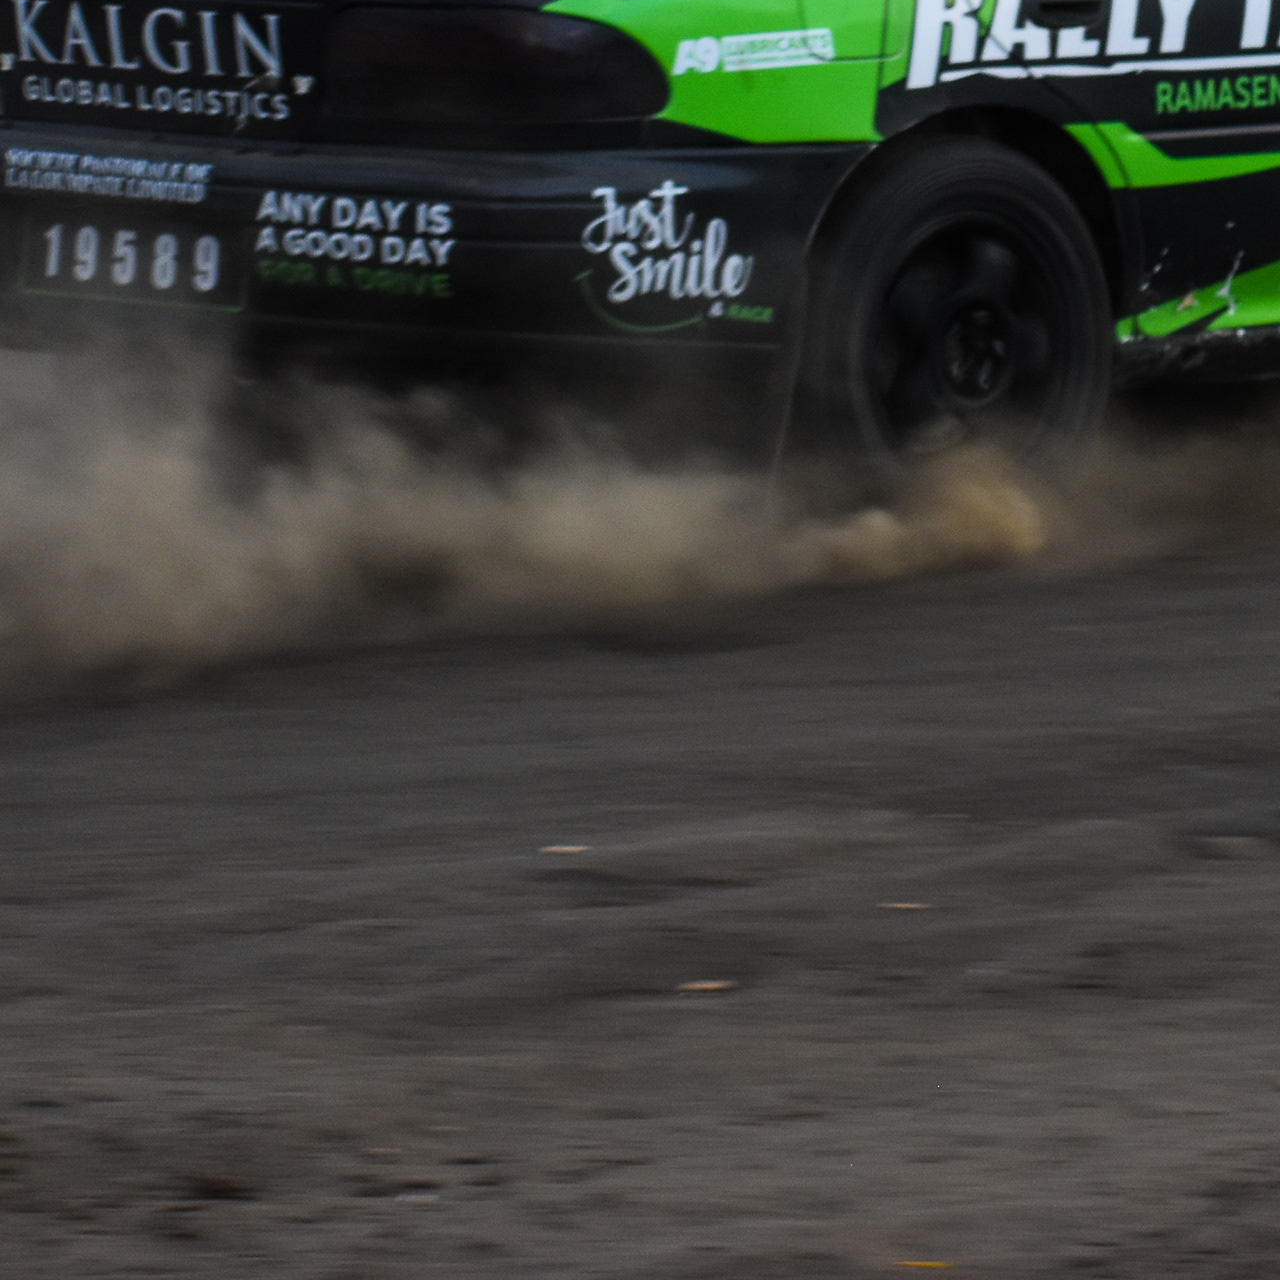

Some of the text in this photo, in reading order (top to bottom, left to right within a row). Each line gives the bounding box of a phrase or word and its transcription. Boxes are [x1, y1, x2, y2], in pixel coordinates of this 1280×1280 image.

[22, 75, 290, 121] GLOBAL LOGISTICS
[256, 189, 453, 235] ANY DAY IS
[580, 179, 696, 254] Just
[43, 223, 221, 293] 19589
[254, 225, 456, 268] A GOOD DAY
[607, 217, 755, 304] Smile
